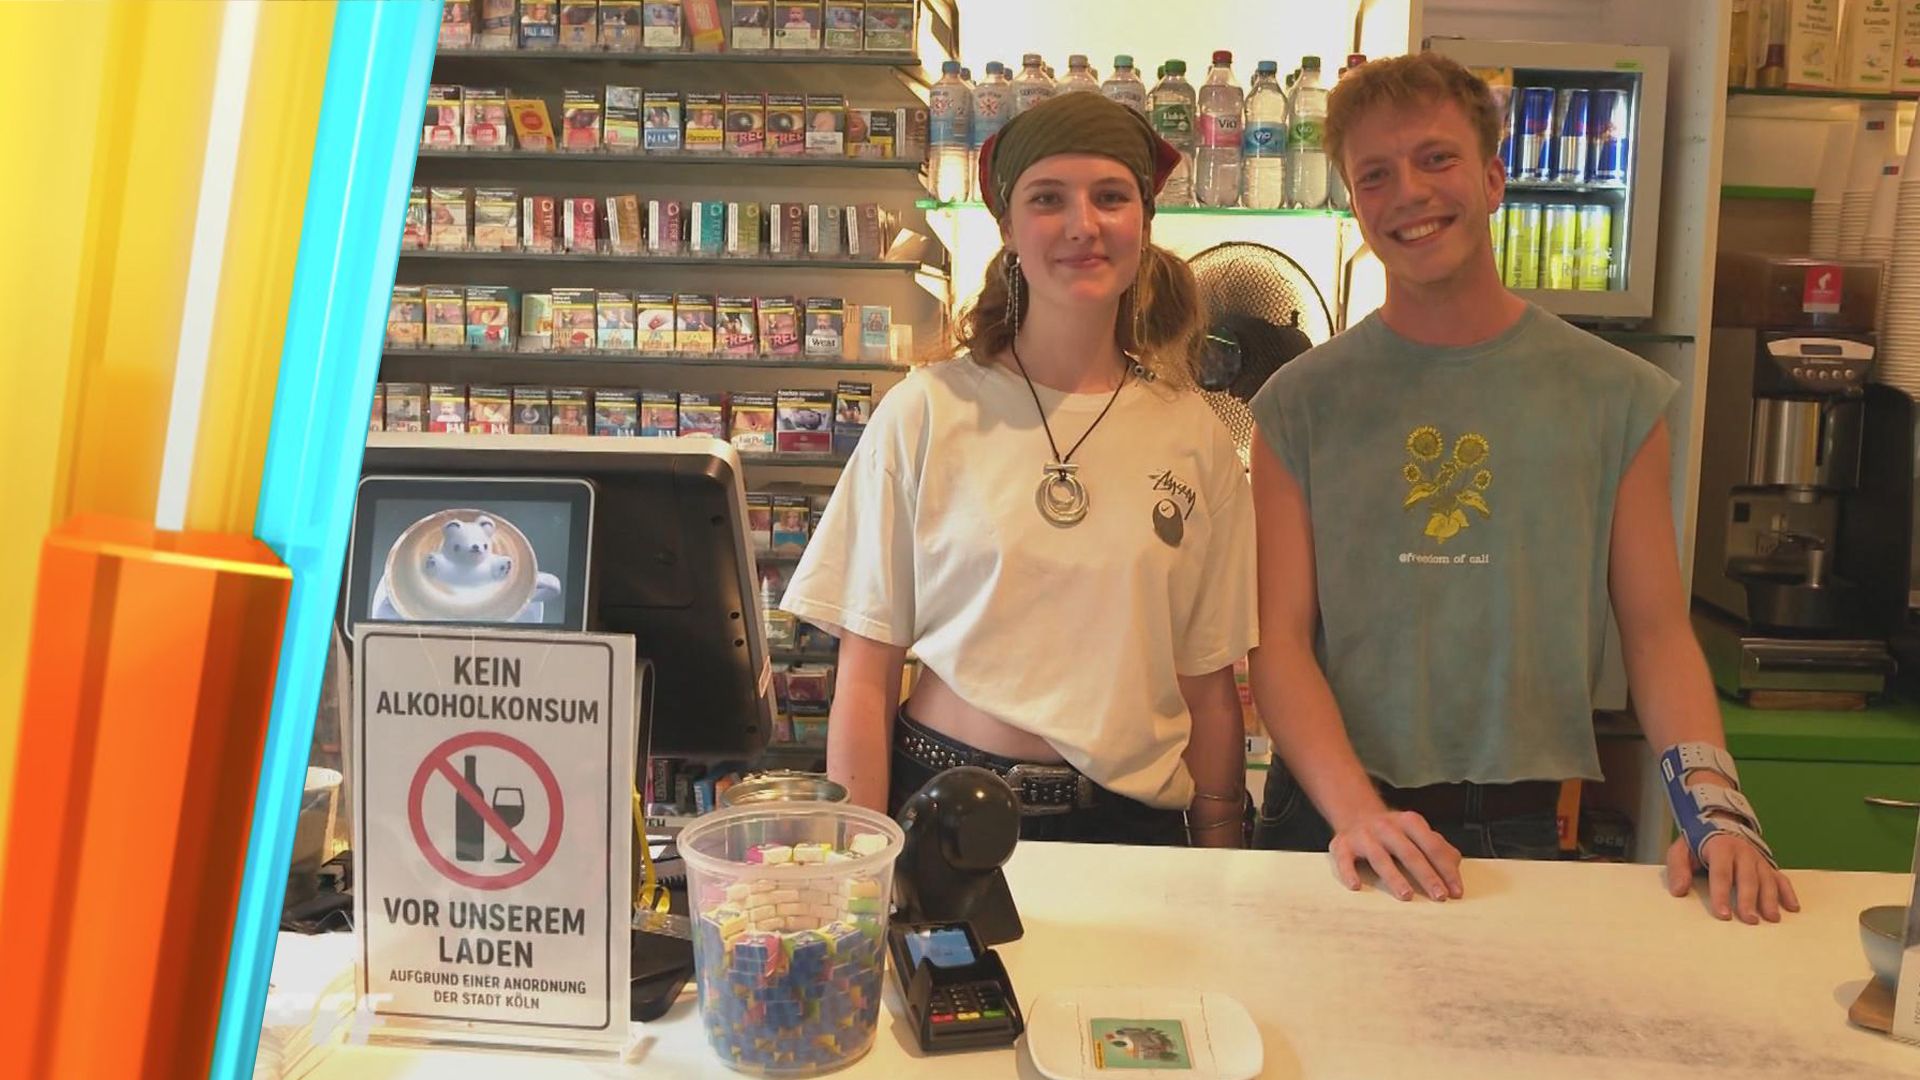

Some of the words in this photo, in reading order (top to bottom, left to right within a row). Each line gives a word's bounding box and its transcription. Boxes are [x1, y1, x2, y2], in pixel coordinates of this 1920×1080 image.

[1453, 553, 1466, 564] of
[453, 655, 521, 688] KEIN
[376, 690, 599, 725] ALKOHOLKONSUM
[383, 897, 440, 927] VOR
[449, 901, 586, 936] UNSEREM
[439, 936, 533, 968] LADEN
[389, 969, 459, 987] AUFGRUND
[463, 973, 500, 990] EINER
[504, 976, 587, 994] ANORDNUNG
[433, 990, 458, 1004] DER
[462, 993, 501, 1007] STADT
[505, 992, 540, 1009] KÖLN
